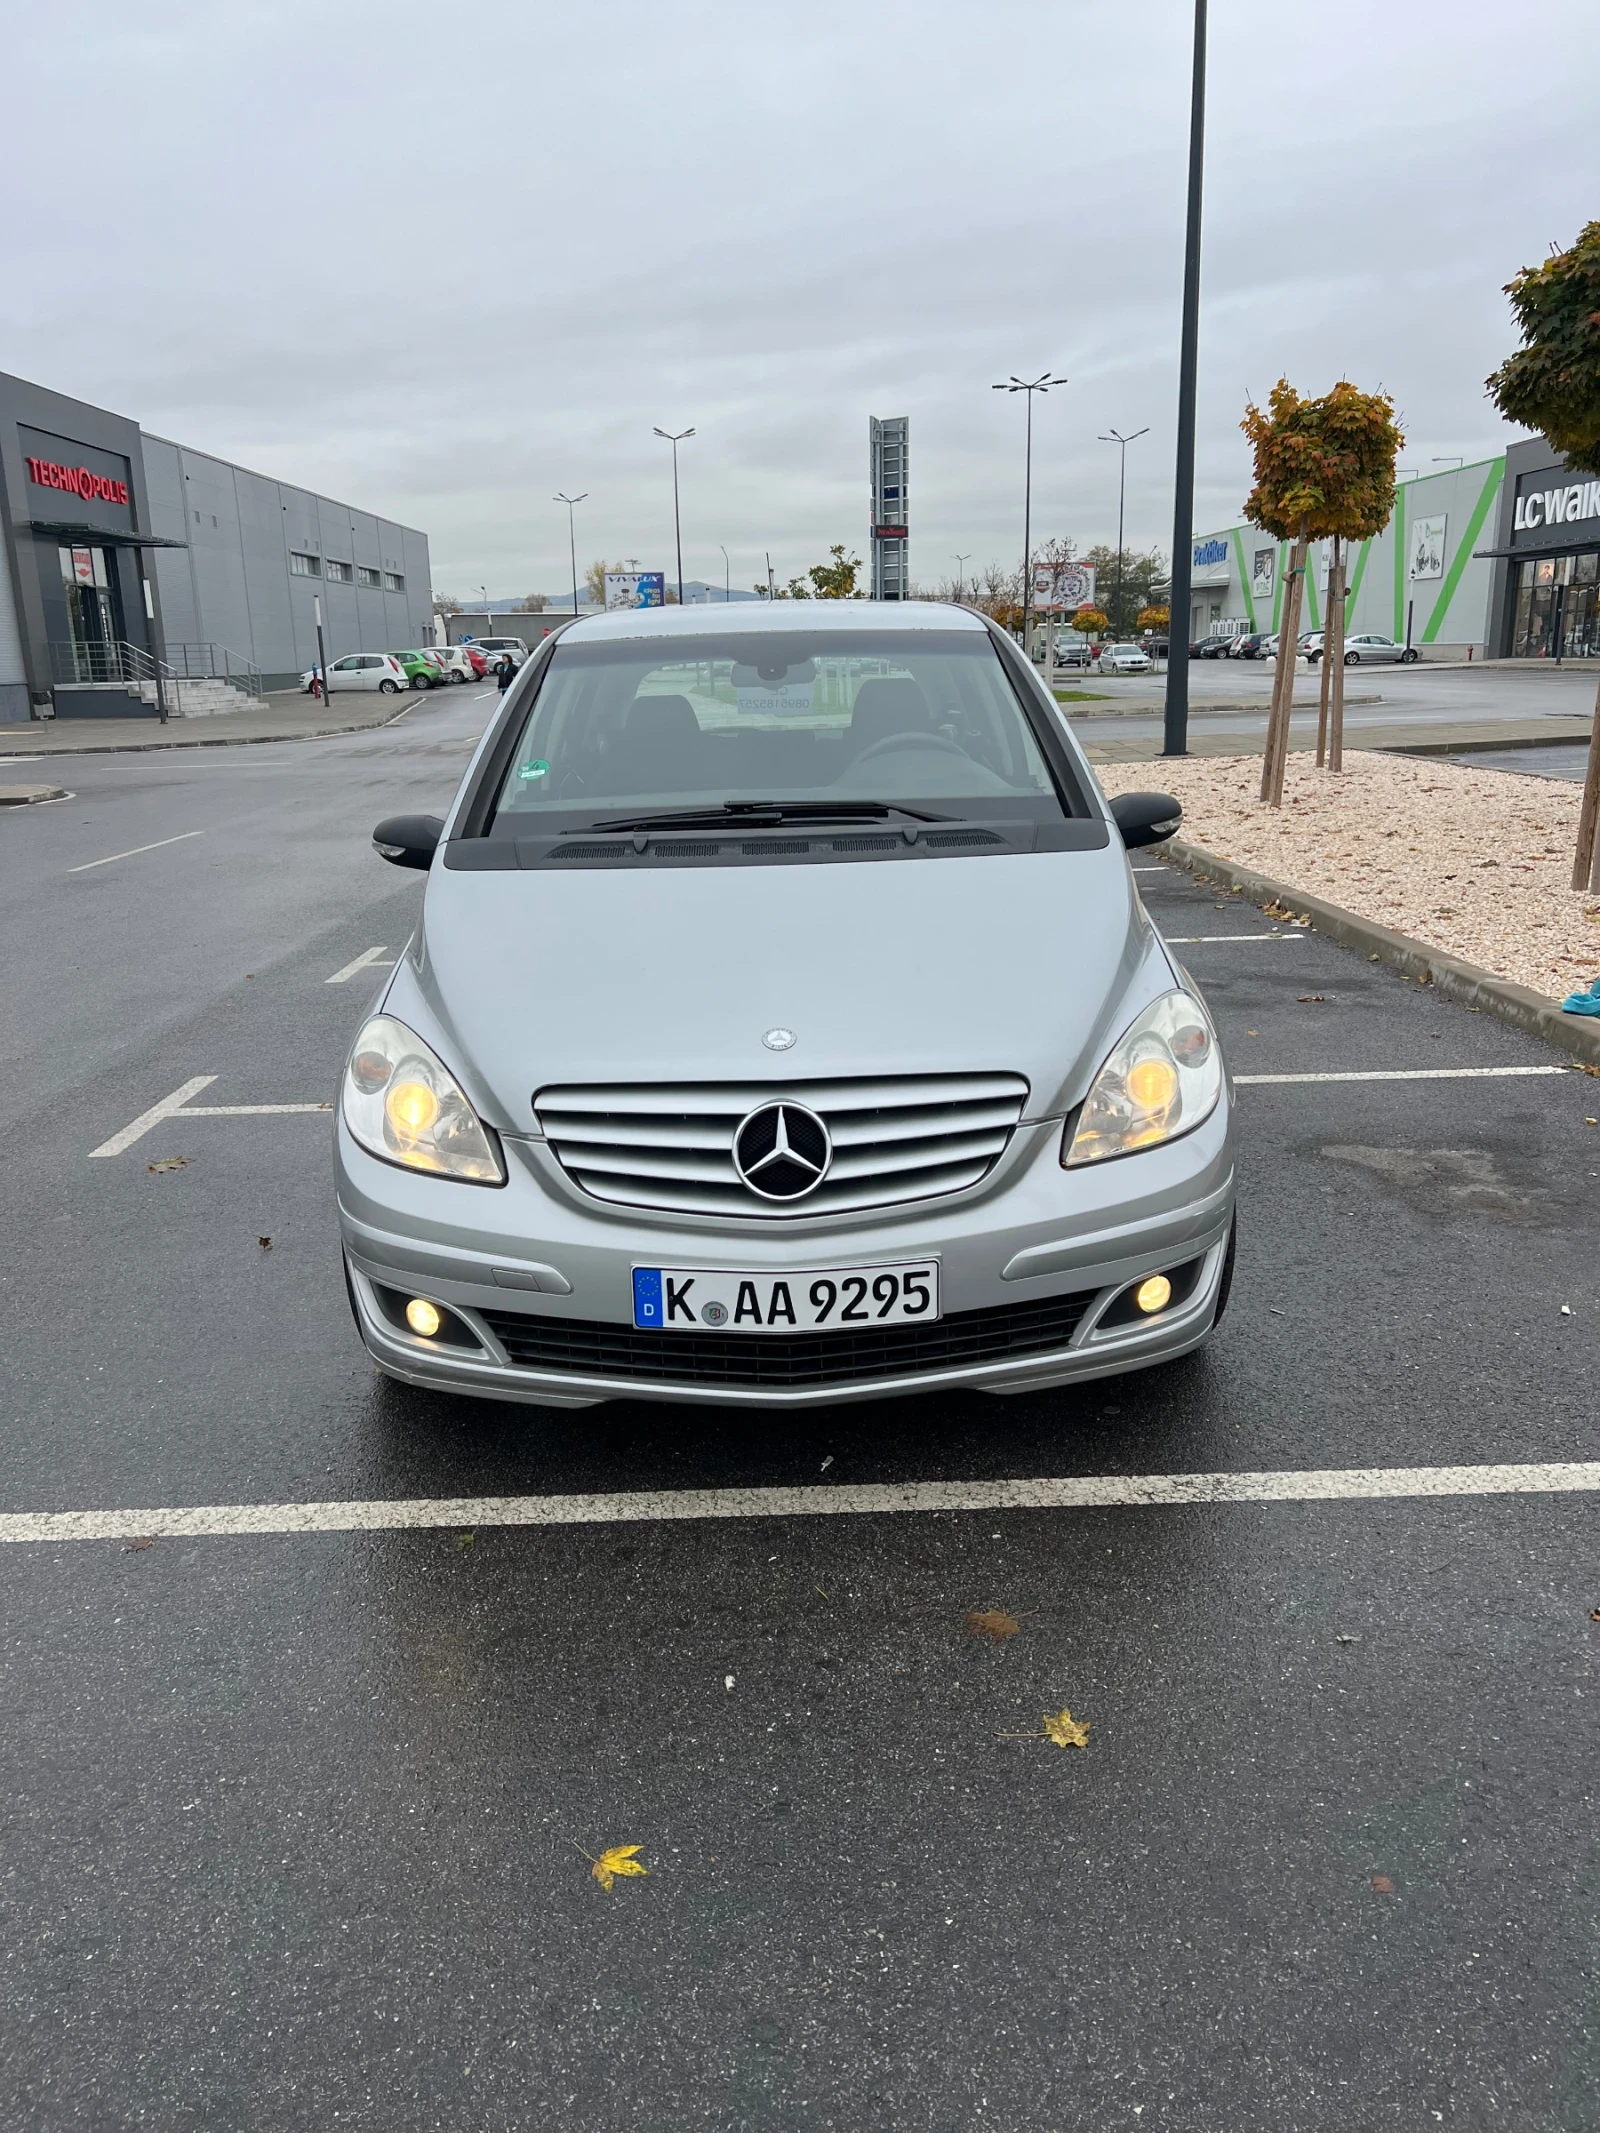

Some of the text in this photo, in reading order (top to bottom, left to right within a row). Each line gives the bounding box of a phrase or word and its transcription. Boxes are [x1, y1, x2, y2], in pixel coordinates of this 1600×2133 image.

[26, 457, 128, 504] TECHNOPOLIS
[1194, 540, 1228, 566] Praktiker
[644, 1270, 931, 1325] D K AA 9295
